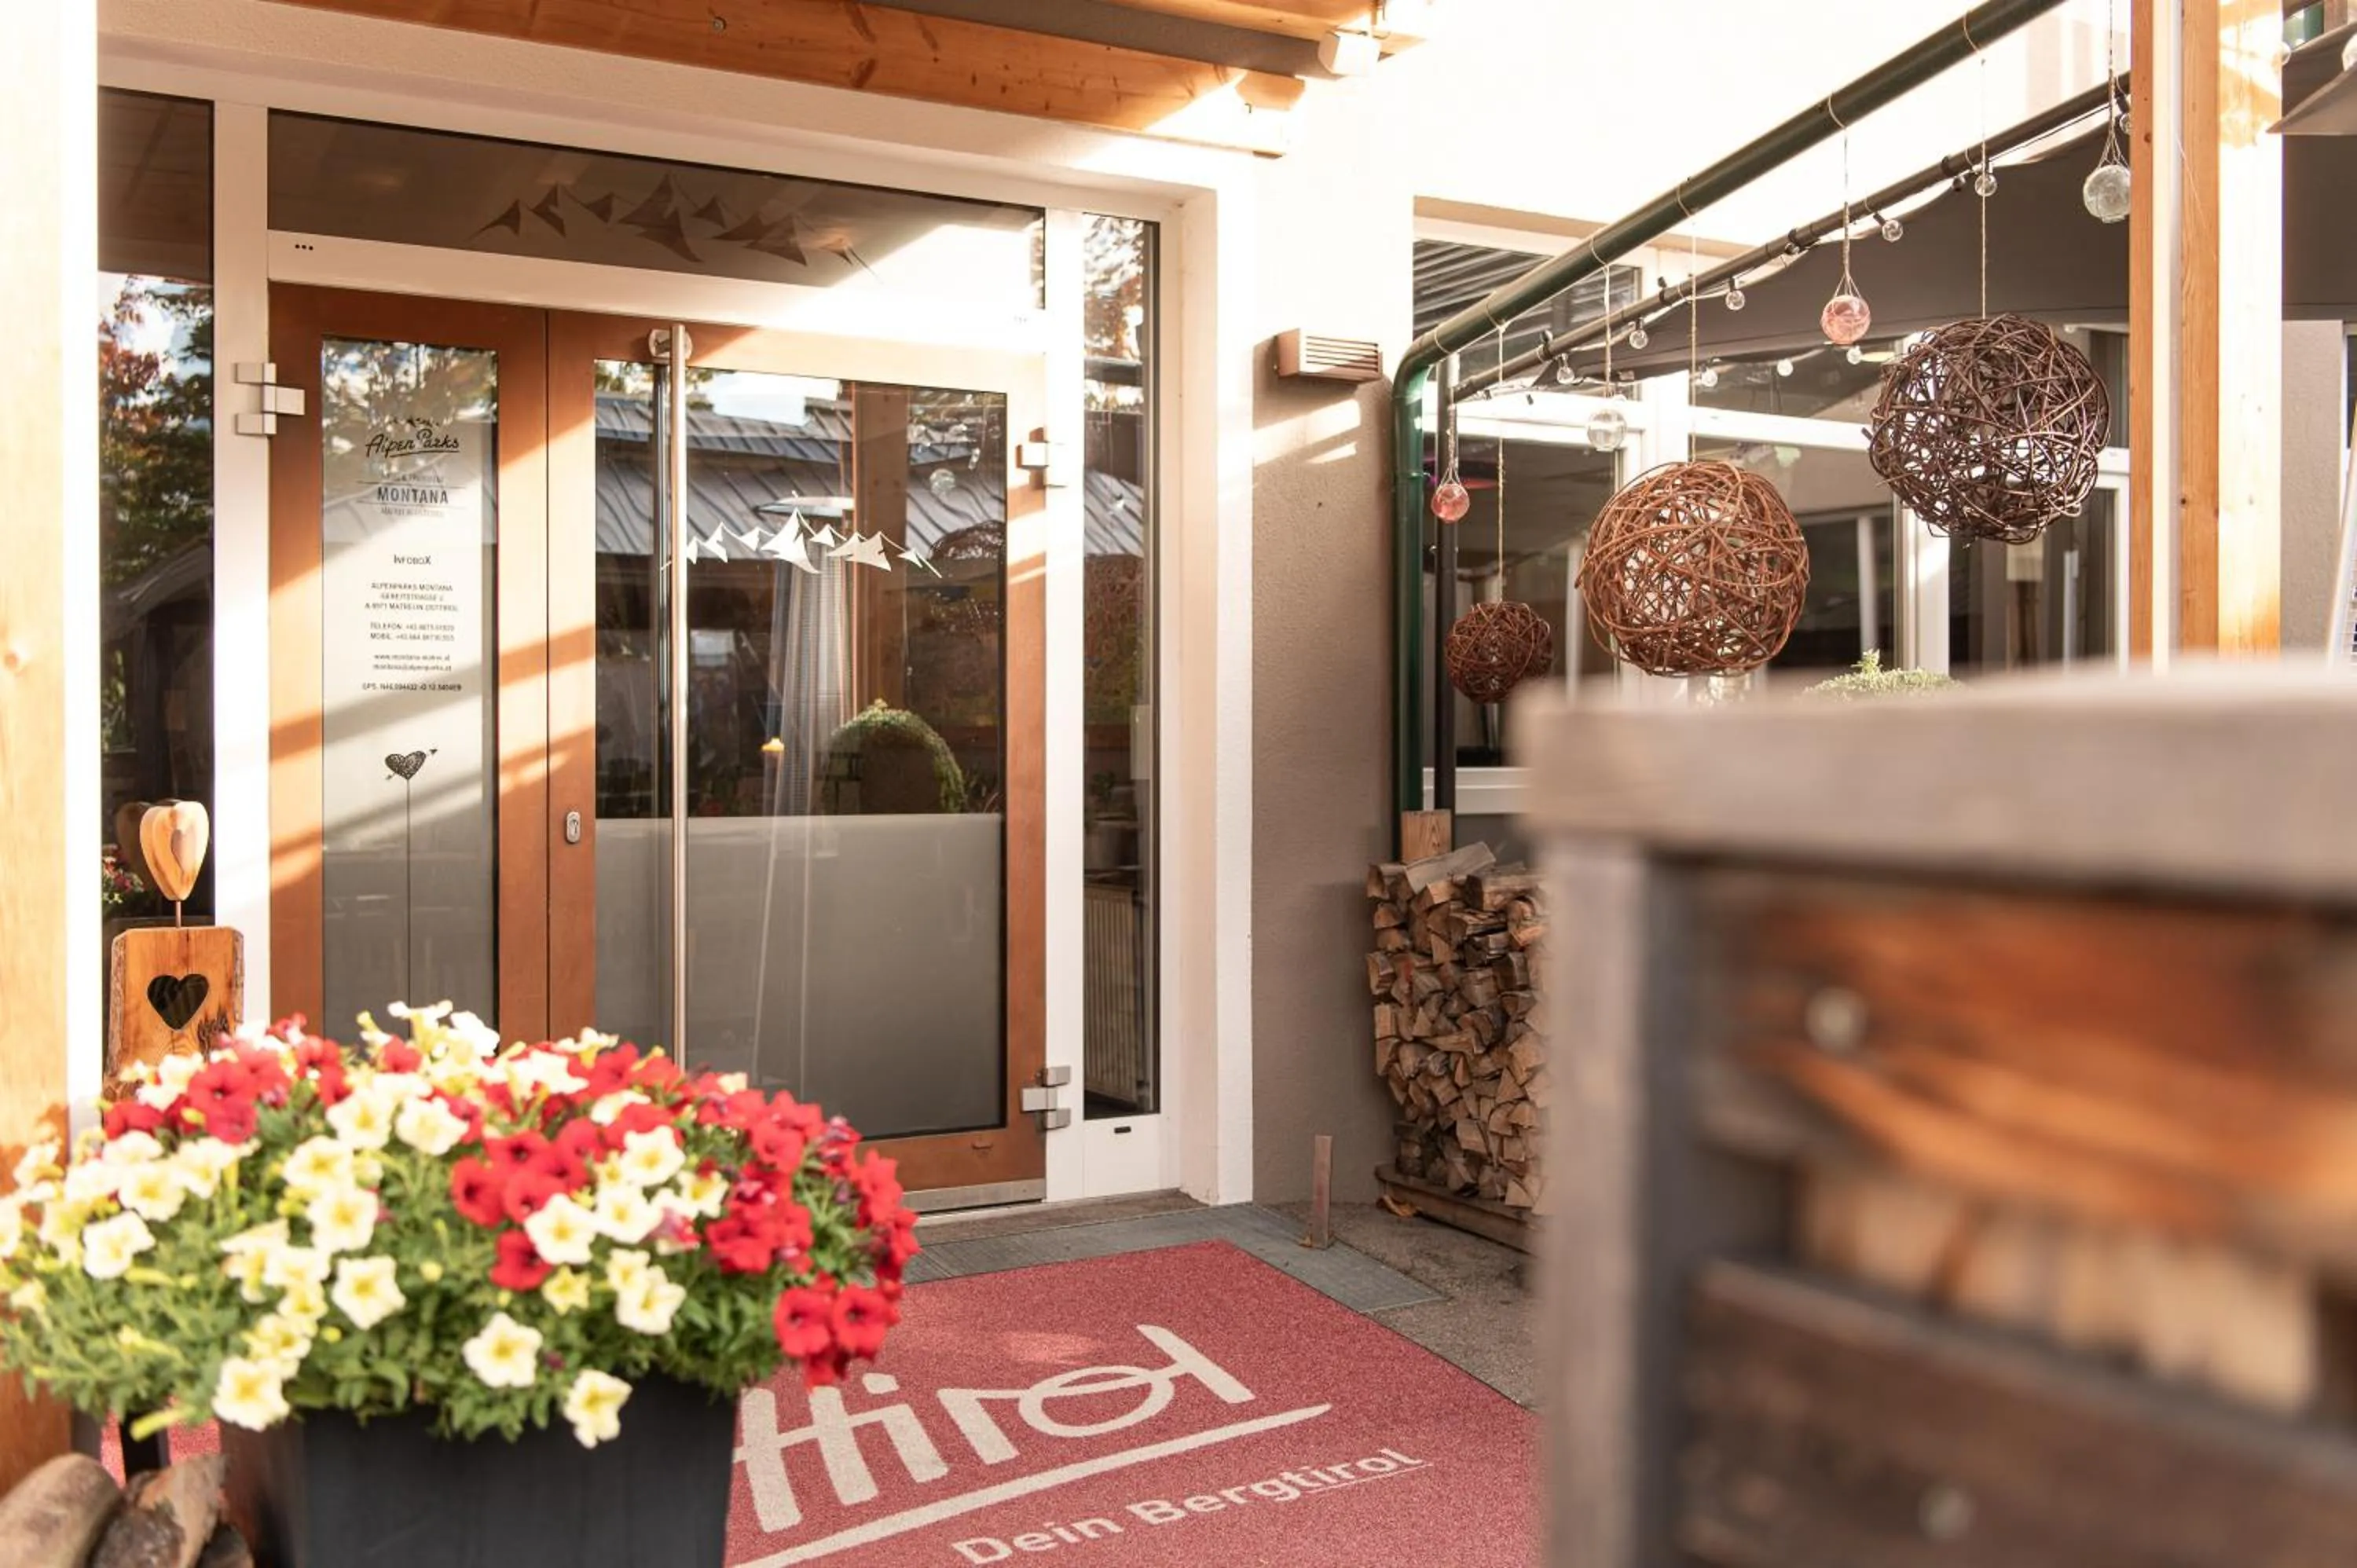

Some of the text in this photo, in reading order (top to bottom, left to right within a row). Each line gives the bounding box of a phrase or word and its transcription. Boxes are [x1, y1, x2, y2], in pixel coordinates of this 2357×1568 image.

[365, 428, 460, 458] Alpen Parks
[377, 486, 449, 504] MONTANA
[951, 1447, 1424, 1566] Dein Bergtirol
